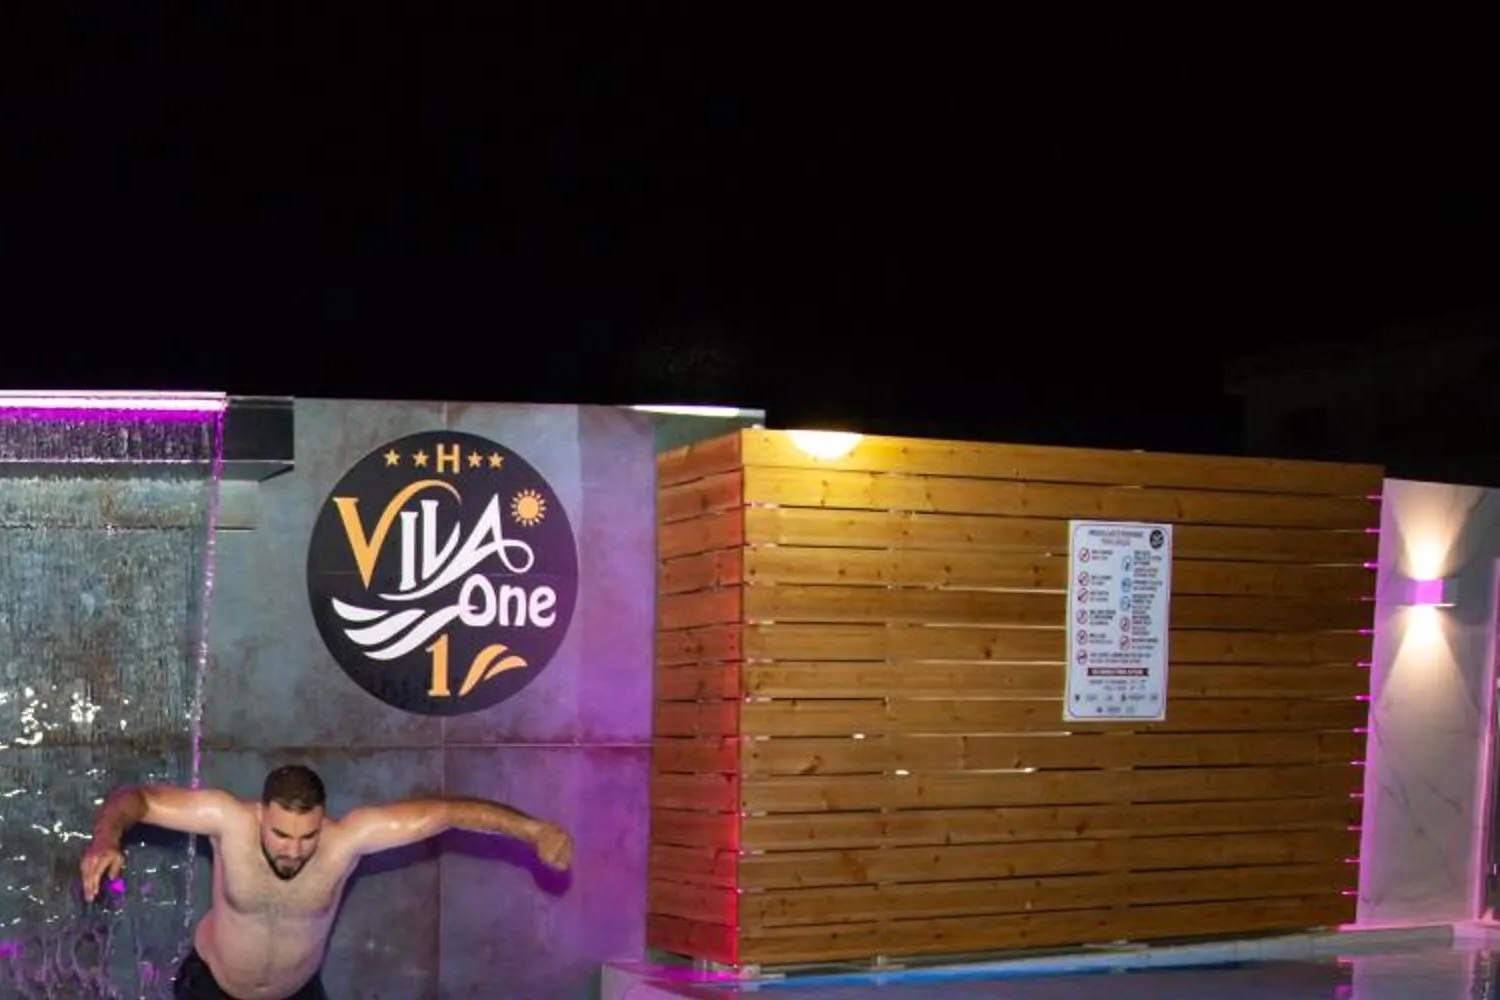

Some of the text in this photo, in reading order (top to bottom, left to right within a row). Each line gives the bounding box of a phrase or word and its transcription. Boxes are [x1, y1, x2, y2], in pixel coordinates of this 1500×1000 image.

[436, 443, 460, 474] H
[459, 573, 557, 628] One
[426, 633, 450, 697] 1
